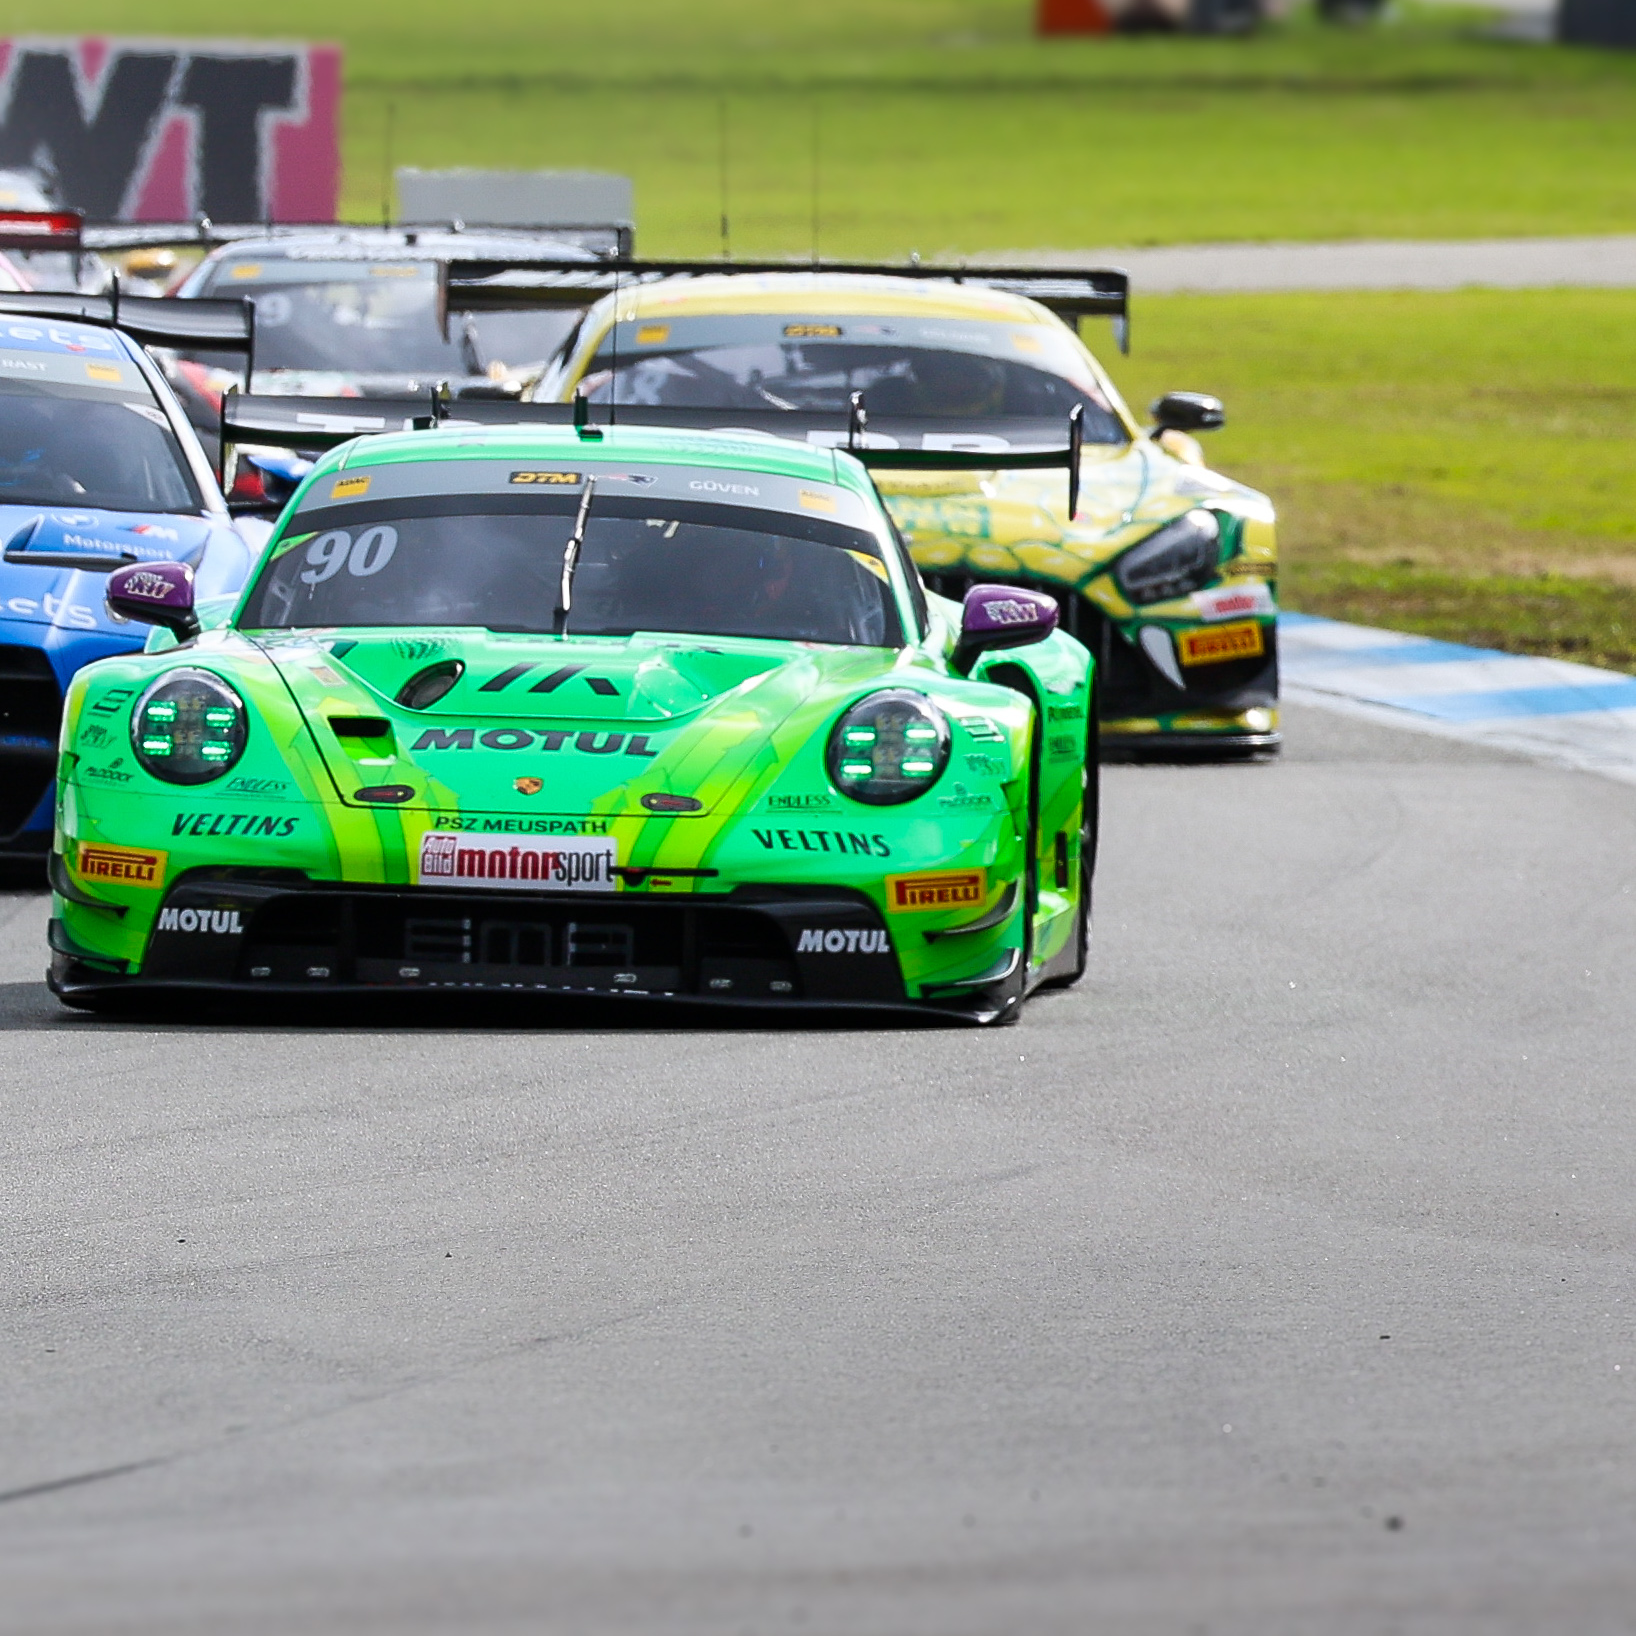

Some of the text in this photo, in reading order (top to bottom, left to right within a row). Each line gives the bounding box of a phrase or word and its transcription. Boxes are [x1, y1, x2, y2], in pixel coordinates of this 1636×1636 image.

[510, 473, 580, 484] DTM
[689, 479, 760, 496] GÜVEN
[63, 532, 174, 561] Motorsport
[300, 525, 399, 584] 90
[410, 728, 660, 757] MOTUL
[171, 813, 300, 837] VELTINS
[435, 816, 607, 834] PSZ MEUSPATH
[752, 828, 891, 857] VELTINS
[81, 849, 158, 881] PIRELLI
[456, 846, 614, 886] motorsport
[895, 875, 980, 905] PIRELLI
[157, 908, 244, 934] MOTUL
[797, 928, 891, 953] MOTUL
